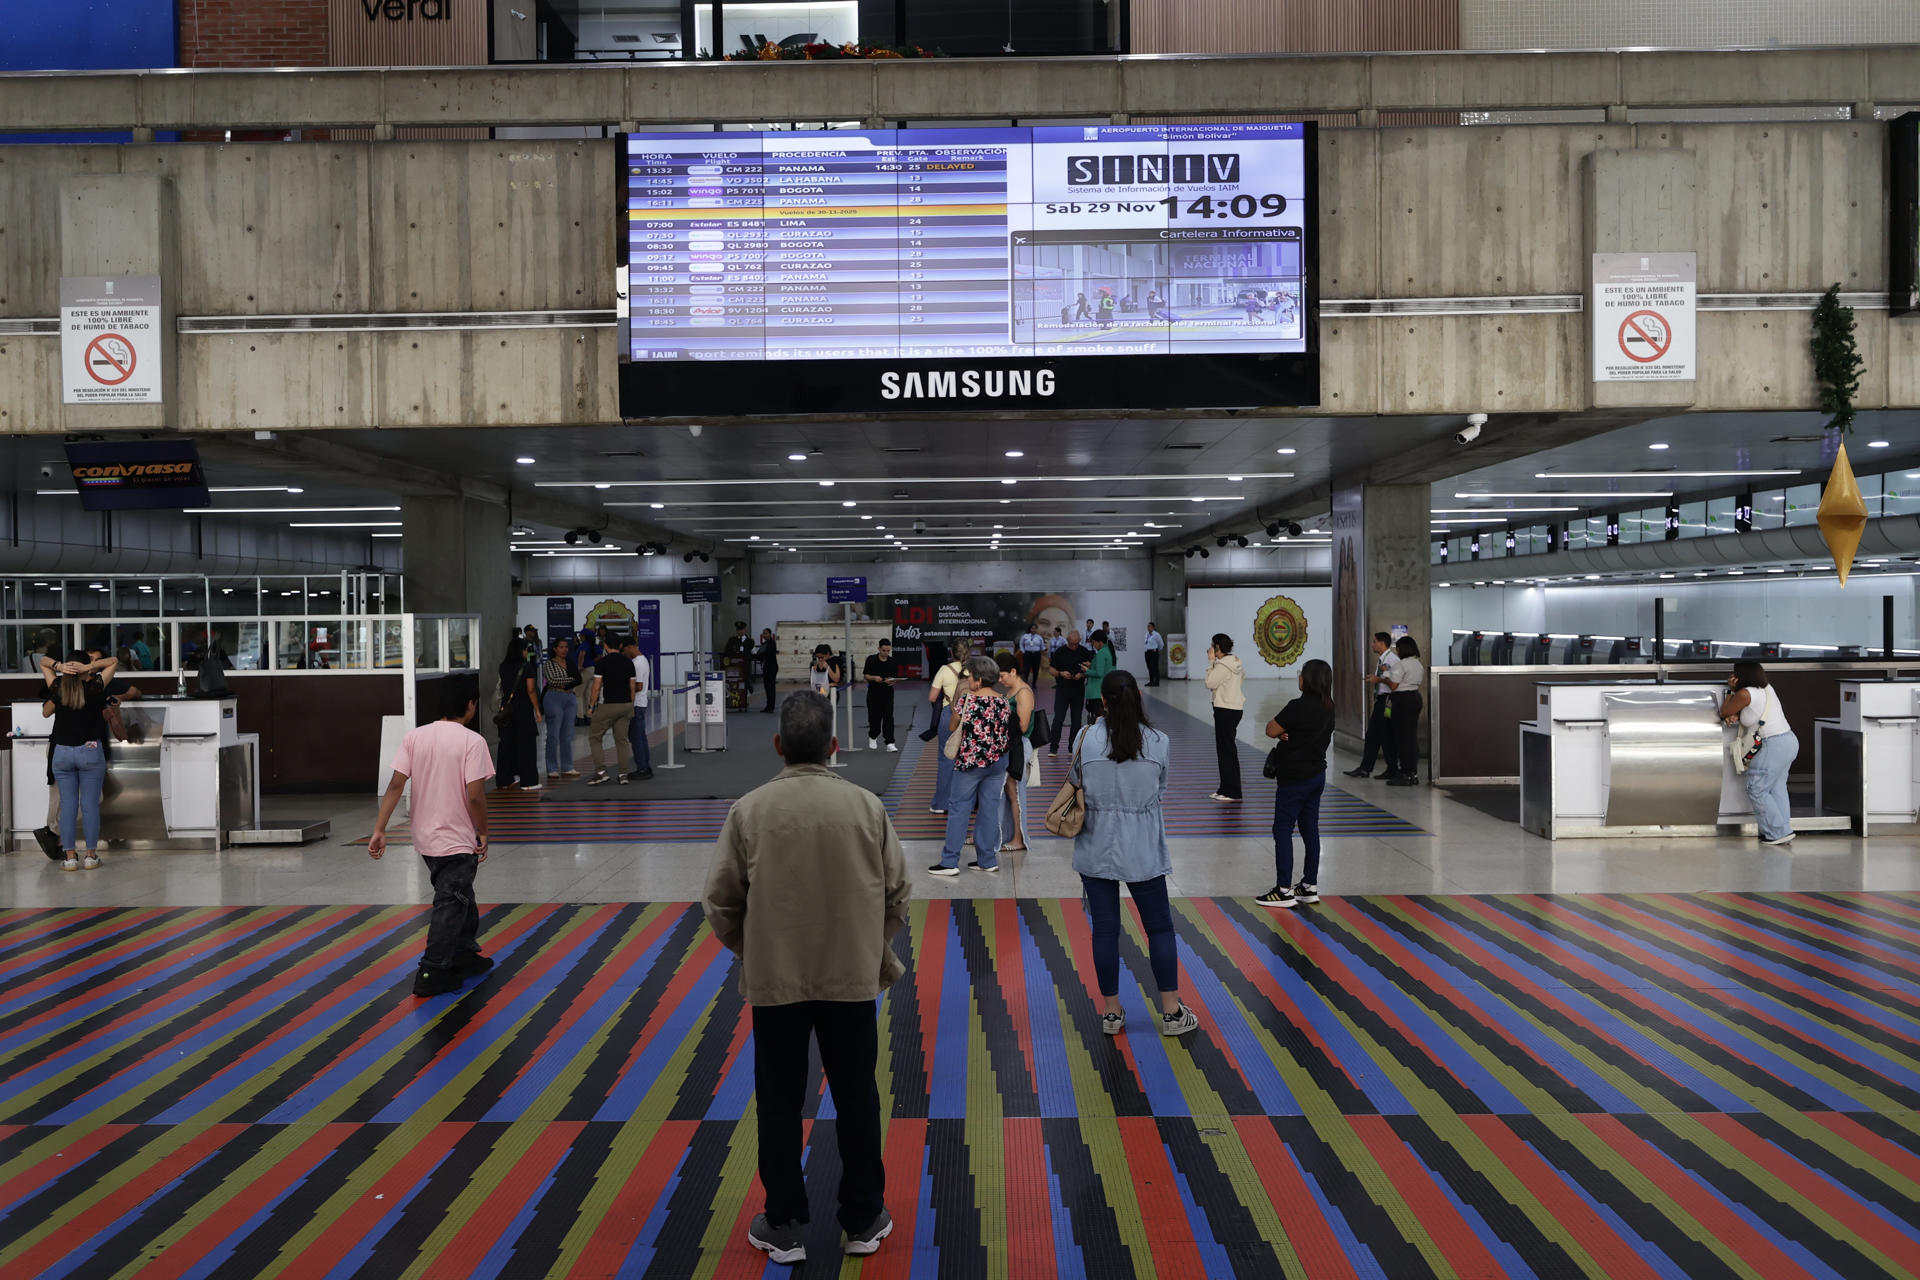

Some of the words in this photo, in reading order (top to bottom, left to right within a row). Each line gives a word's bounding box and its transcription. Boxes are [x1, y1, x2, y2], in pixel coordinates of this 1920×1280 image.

[1070, 155, 1238, 185] SINIV
[1068, 185, 1102, 193] Sistema
[1118, 184, 1169, 192] Información
[1046, 203, 1080, 214] Sab
[1088, 202, 1110, 213] 29
[1117, 202, 1155, 213] Nov
[1159, 194, 1287, 219] 14:09
[1160, 229, 1218, 239] Cartelera
[1221, 228, 1296, 238] Informativa
[1184, 253, 1254, 262] TERMINAL
[1184, 261, 1255, 269] NACIONAL
[731, 349, 789, 358] reminds
[794, 349, 811, 357] its
[859, 348, 888, 356] that
[909, 347, 920, 356] is
[943, 346, 964, 355] site
[969, 346, 1008, 354] 100%
[1012, 345, 1039, 354] free
[1048, 344, 1063, 353] of
[1066, 344, 1113, 352] smoke
[1118, 343, 1157, 352] snuff
[880, 369, 1055, 399] SAMSUNG
[895, 607, 934, 624] LDI
[895, 626, 922, 639] todos
